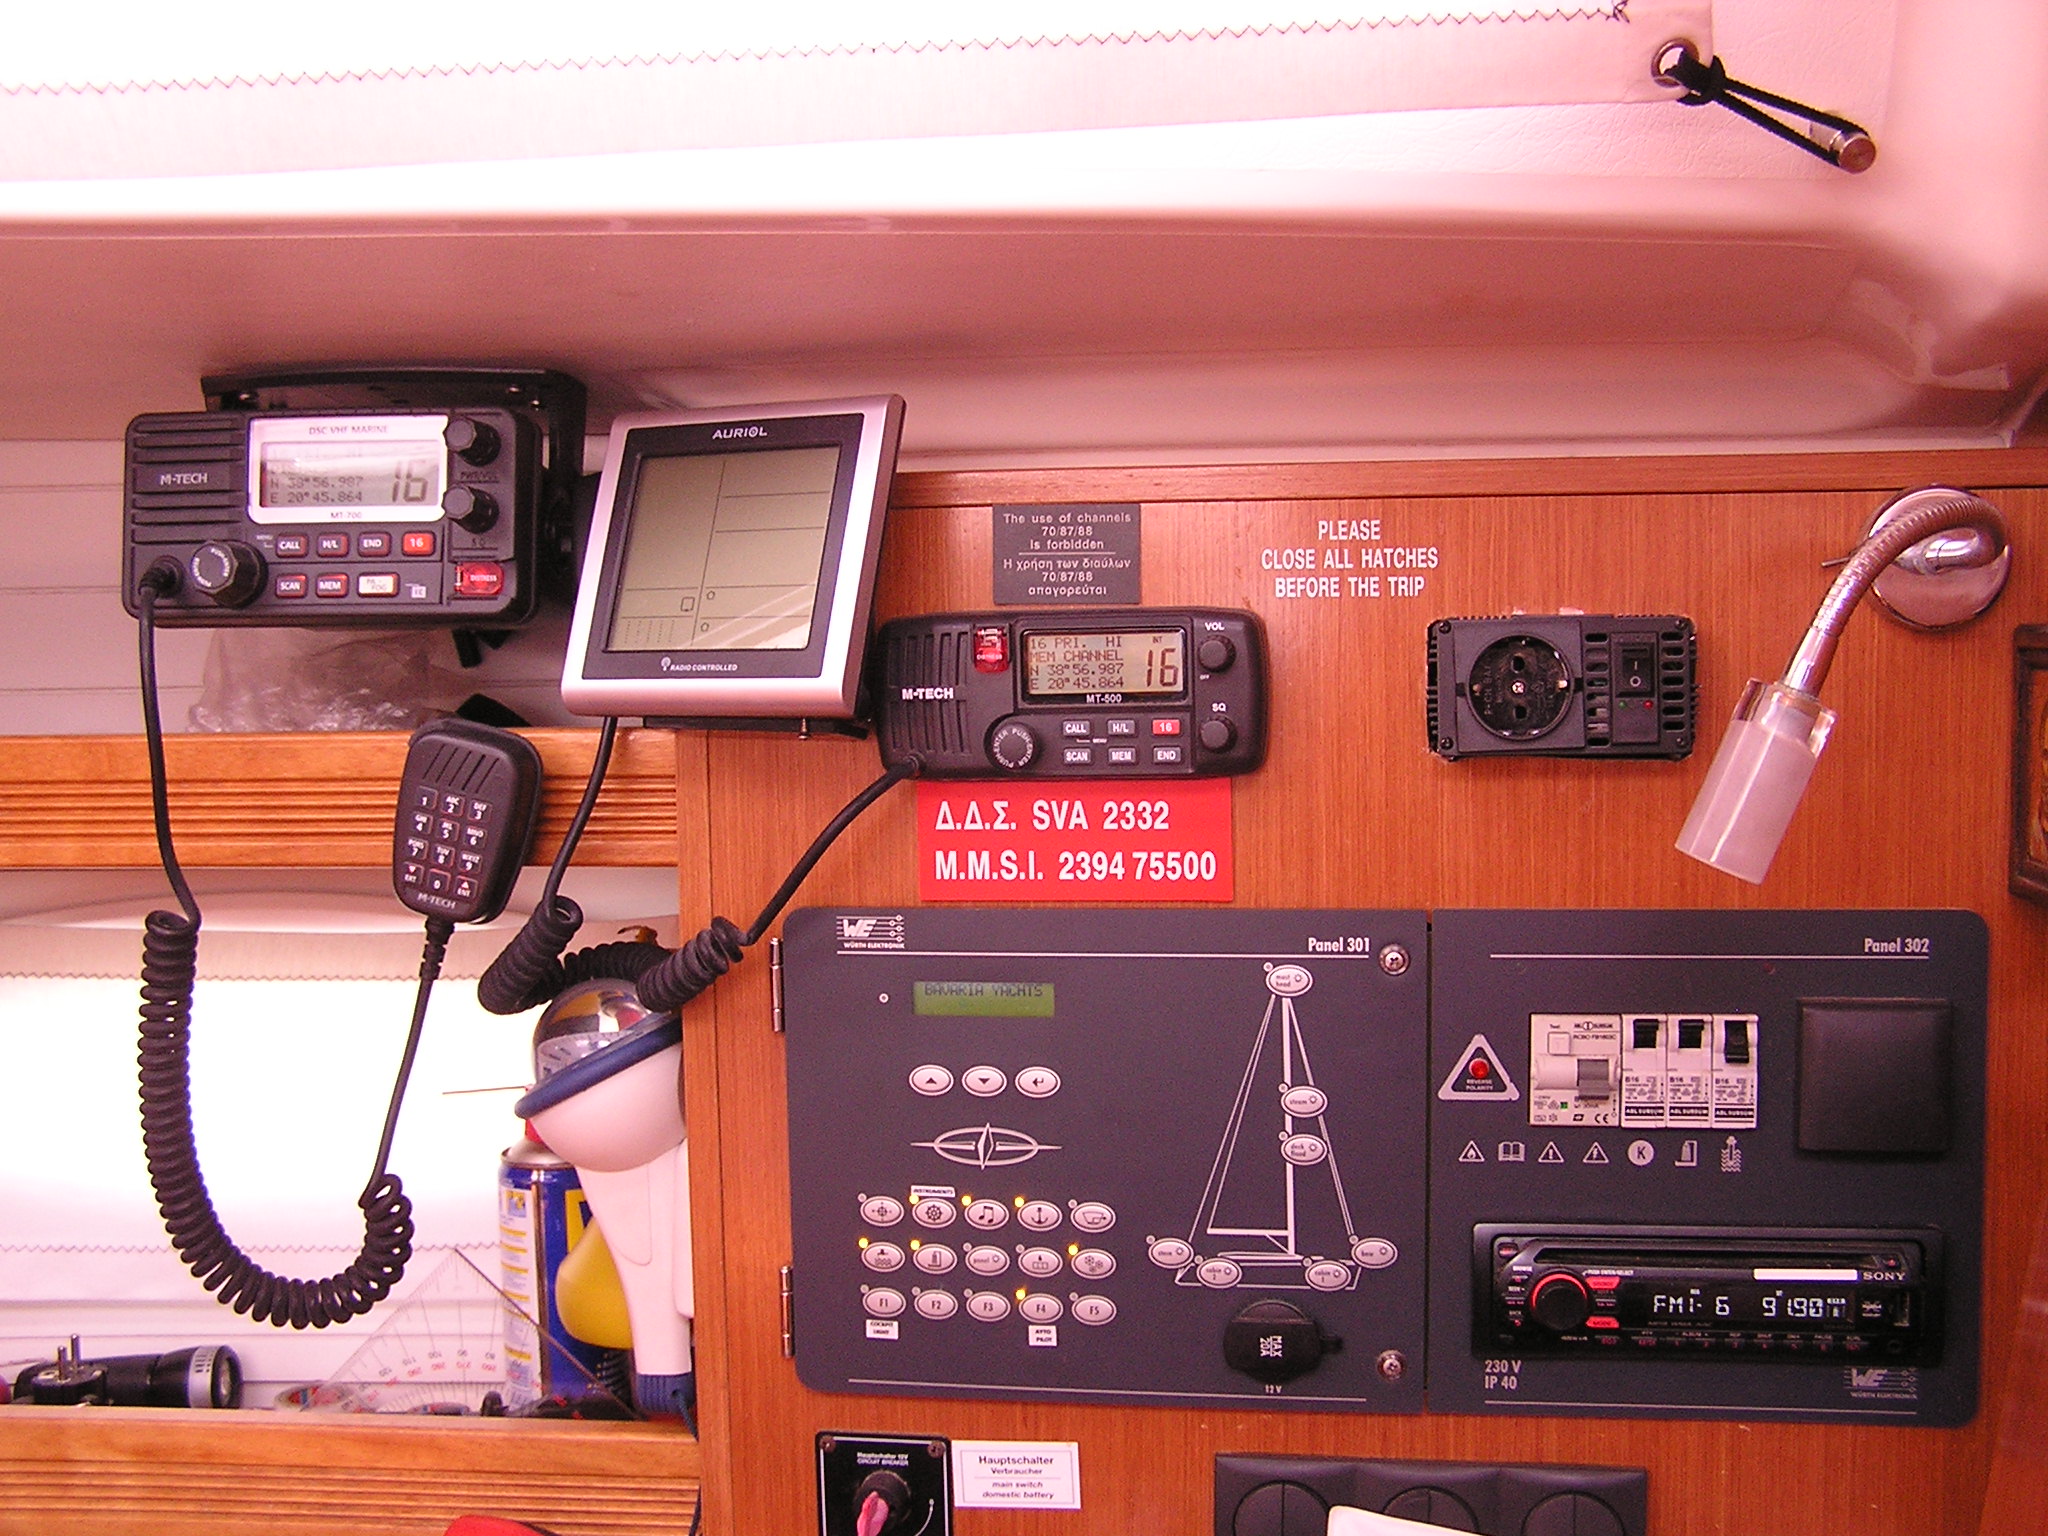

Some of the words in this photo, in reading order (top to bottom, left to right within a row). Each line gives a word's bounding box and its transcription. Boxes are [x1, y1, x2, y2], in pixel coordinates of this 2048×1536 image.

[309, 427, 326, 436] DSC
[330, 426, 348, 435] VHF
[351, 425, 389, 435] MARINE
[712, 426, 768, 440] AURIOL
[160, 473, 208, 486] M-TECH
[392, 460, 429, 503] 16
[270, 493, 278, 504] E
[1003, 513, 1025, 524] The
[1032, 515, 1053, 524] use
[1058, 513, 1071, 523] of
[1077, 512, 1131, 523] channels
[1041, 526, 1093, 537] 70/87/88
[1318, 519, 1381, 541] PLEASE
[279, 540, 300, 550] CALL
[322, 540, 338, 549] H/L
[363, 539, 382, 548] END
[409, 538, 424, 547] 16
[1047, 539, 1104, 550] forbidden
[1261, 548, 1316, 570] CLOSE
[1323, 548, 1354, 569] ALL
[1361, 547, 1439, 569] HATCHES
[1016, 558, 1053, 571] χρήση
[1056, 560, 1078, 569] των
[1082, 557, 1131, 569] διαύλων
[1042, 571, 1093, 582] 70/87/88
[280, 582, 300, 591] SCAN
[319, 581, 341, 591] MEM
[1275, 577, 1340, 598] BEFORE
[1347, 576, 1380, 597] THE
[1387, 576, 1425, 597] TRIP
[1205, 622, 1225, 631] VOL
[1030, 638, 1047, 649] 16
[1105, 636, 1122, 647] HI
[1029, 652, 1056, 663] MEM
[1063, 649, 1124, 662] CHANNEL
[1030, 665, 1039, 676] N
[1146, 648, 1179, 688] 16
[1031, 678, 1039, 690] E
[902, 686, 954, 700] M-TECH
[1086, 693, 1122, 703] MT-500
[1212, 703, 1227, 713] SQ
[1065, 723, 1087, 733] CALL
[1112, 722, 1129, 733] H/L
[1159, 722, 1173, 732] 16
[1066, 751, 1088, 761] SCAN
[1112, 750, 1132, 760] MEM
[1157, 750, 1176, 760] END
[421, 796, 428, 806] 1
[447, 804, 455, 813] 2
[475, 810, 482, 820] 3
[935, 800, 1017, 830] Δ.Δ.Σ.
[1032, 799, 1089, 831] SVA
[1103, 800, 1170, 830] 2332
[416, 823, 423, 832] 4
[442, 829, 449, 839] 5
[470, 837, 477, 846] 6
[412, 847, 419, 856] 7
[438, 855, 445, 864] 8
[465, 861, 473, 871] 9
[935, 850, 1044, 880] M.M.S.I.
[1058, 851, 1125, 880] 2394
[1132, 850, 1217, 881] 75500
[433, 880, 441, 889] 0
[417, 893, 456, 908] M-TECH
[1308, 937, 1344, 952] Panel
[1347, 938, 1370, 952] 301
[1864, 937, 1901, 953] Panel
[1904, 938, 1929, 953] 302
[924, 984, 984, 996] BAVARIA
[993, 984, 1043, 997] YACHTS
[1863, 1271, 1906, 1280] SONY
[879, 1299, 888, 1308] F1
[932, 1301, 941, 1310] F2
[984, 1302, 993, 1311] F3
[1036, 1304, 1046, 1313] F4
[1715, 1296, 1730, 1315] 6
[1090, 1306, 1100, 1315] F5
[1272, 1336, 1283, 1357] MAX
[1485, 1360, 1509, 1373] 230
[1511, 1360, 1521, 1373] V
[1485, 1375, 1498, 1389] IP
[1501, 1375, 1517, 1389] 40
[978, 1456, 1054, 1466] Hauptschalter
[991, 1467, 1042, 1475] Verbraucher
[1023, 1491, 1055, 1499] battery
